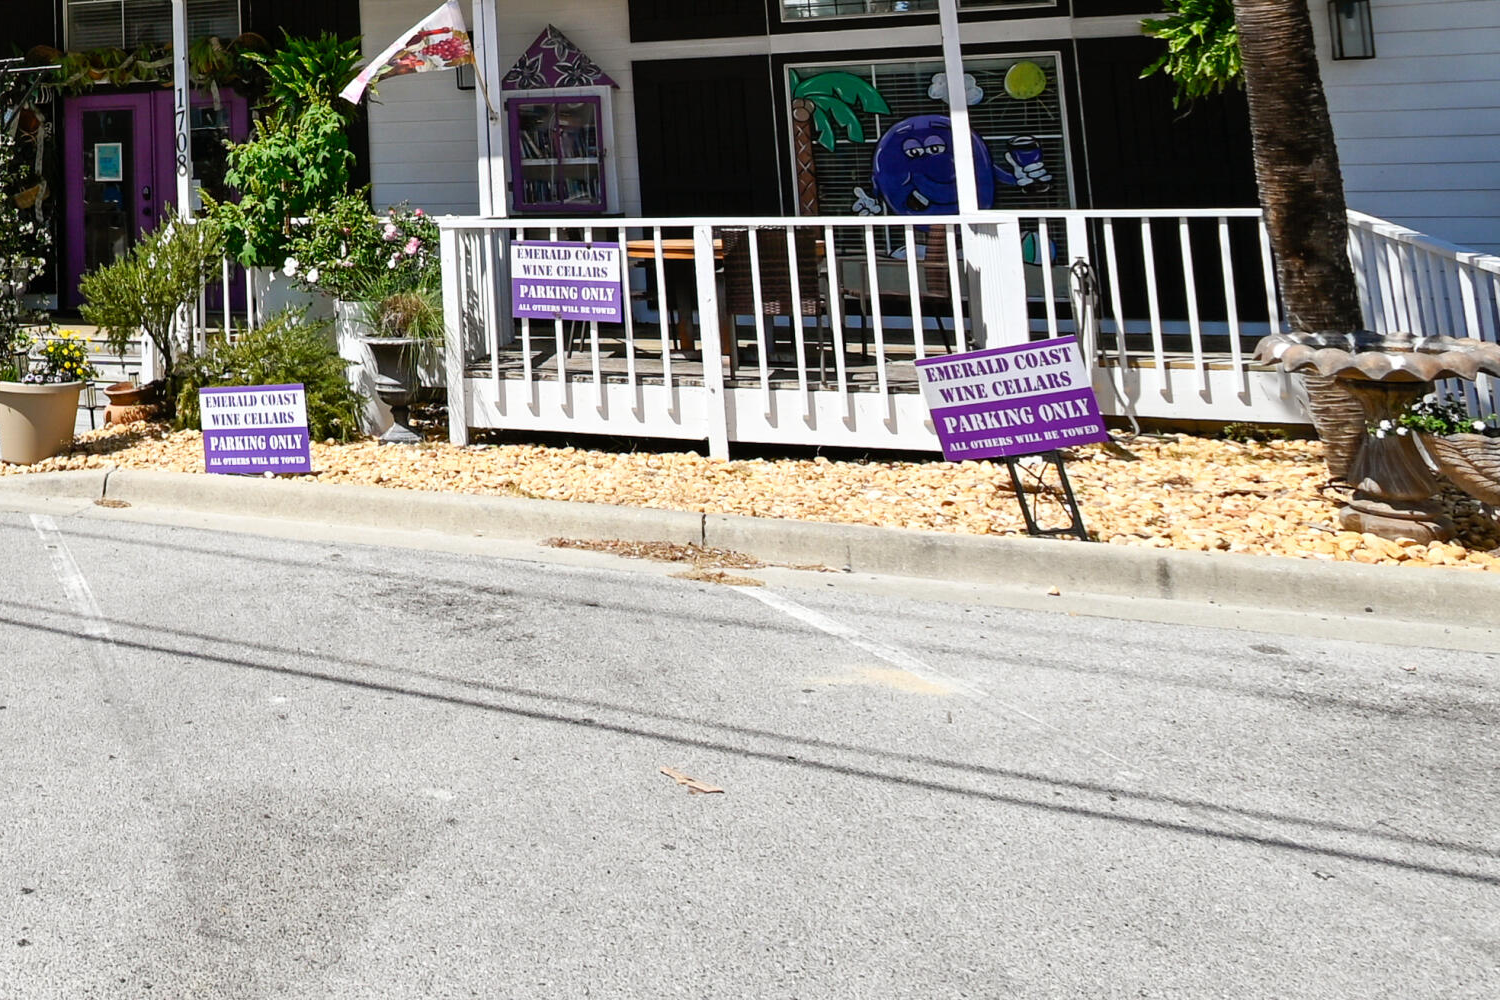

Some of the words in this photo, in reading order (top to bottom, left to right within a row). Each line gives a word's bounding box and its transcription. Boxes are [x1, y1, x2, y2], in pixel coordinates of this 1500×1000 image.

[175, 87, 188, 177] 1708
[517, 248, 571, 260] EMERALD
[575, 249, 612, 262] COAST
[522, 264, 553, 276] WINE
[556, 265, 608, 278] CELLARS
[519, 285, 578, 300] PARKING
[581, 287, 615, 302] ONLY
[924, 358, 1010, 383] EMERALD
[1014, 346, 1073, 370] COAST
[939, 383, 989, 404] WINE
[991, 371, 1073, 397] CELLARS
[205, 394, 257, 408] EMERALD
[260, 392, 298, 406] COAST
[211, 413, 241, 426] WINE
[244, 411, 295, 425] CELLARS
[942, 406, 1036, 434] PARKING
[1038, 398, 1091, 422] ONLY
[209, 435, 267, 452] PARKING
[269, 434, 303, 450] ONLY
[949, 441, 970, 452] ALL
[970, 436, 1014, 450] OTHERS
[1015, 432, 1043, 445] WILL
[1043, 429, 1060, 441] BE
[1060, 424, 1100, 438] TOWED
[209, 457, 222, 466] ALL
[223, 457, 250, 466] OTHERS
[251, 456, 269, 465] WILL
[280, 456, 306, 465] TOWED
